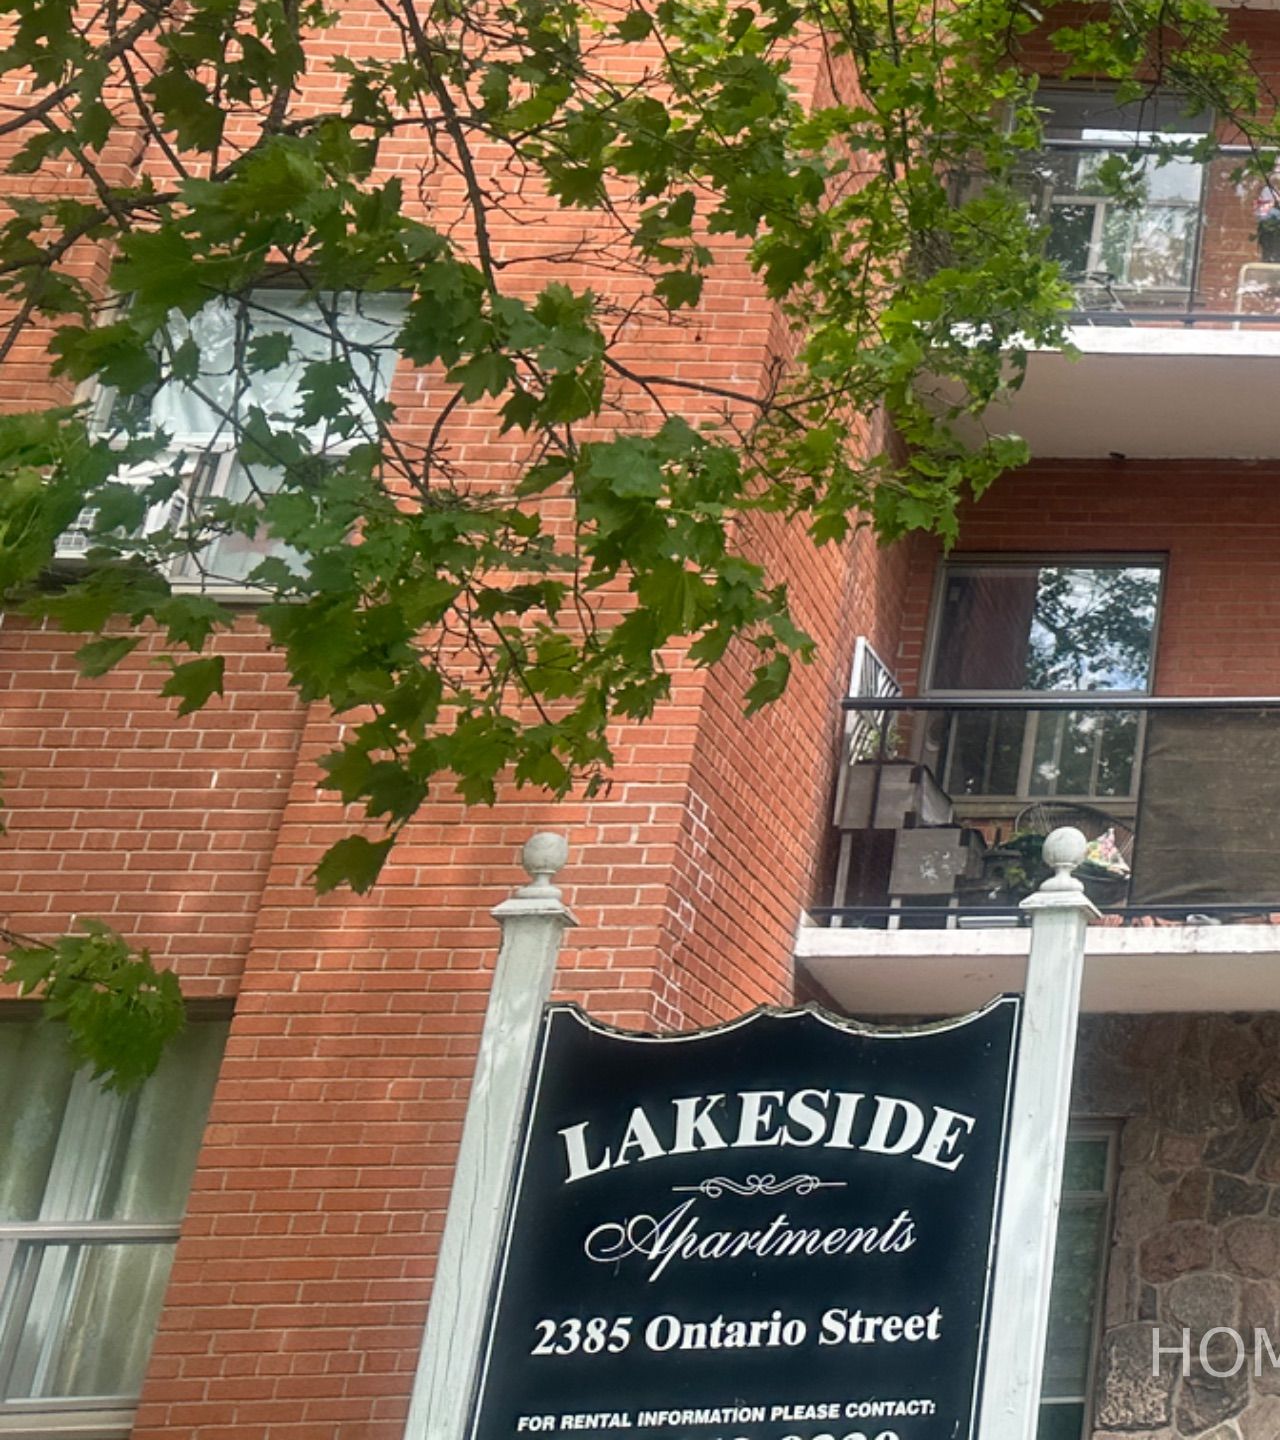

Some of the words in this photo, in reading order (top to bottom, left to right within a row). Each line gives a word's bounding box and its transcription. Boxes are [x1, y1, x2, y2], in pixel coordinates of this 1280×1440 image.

[557, 1088, 976, 1184] LAKESIDE
[583, 1196, 917, 1282] Apartments
[530, 1315, 633, 1356] 2385
[644, 1309, 807, 1351] Ontario
[819, 1307, 943, 1347] Street
[517, 1415, 555, 1432] FOR
[560, 1412, 632, 1430] RENTAL
[637, 1406, 765, 1428] INFORMATION
[770, 1403, 840, 1421] PLEASE
[845, 1399, 936, 1418] CONTACT:
